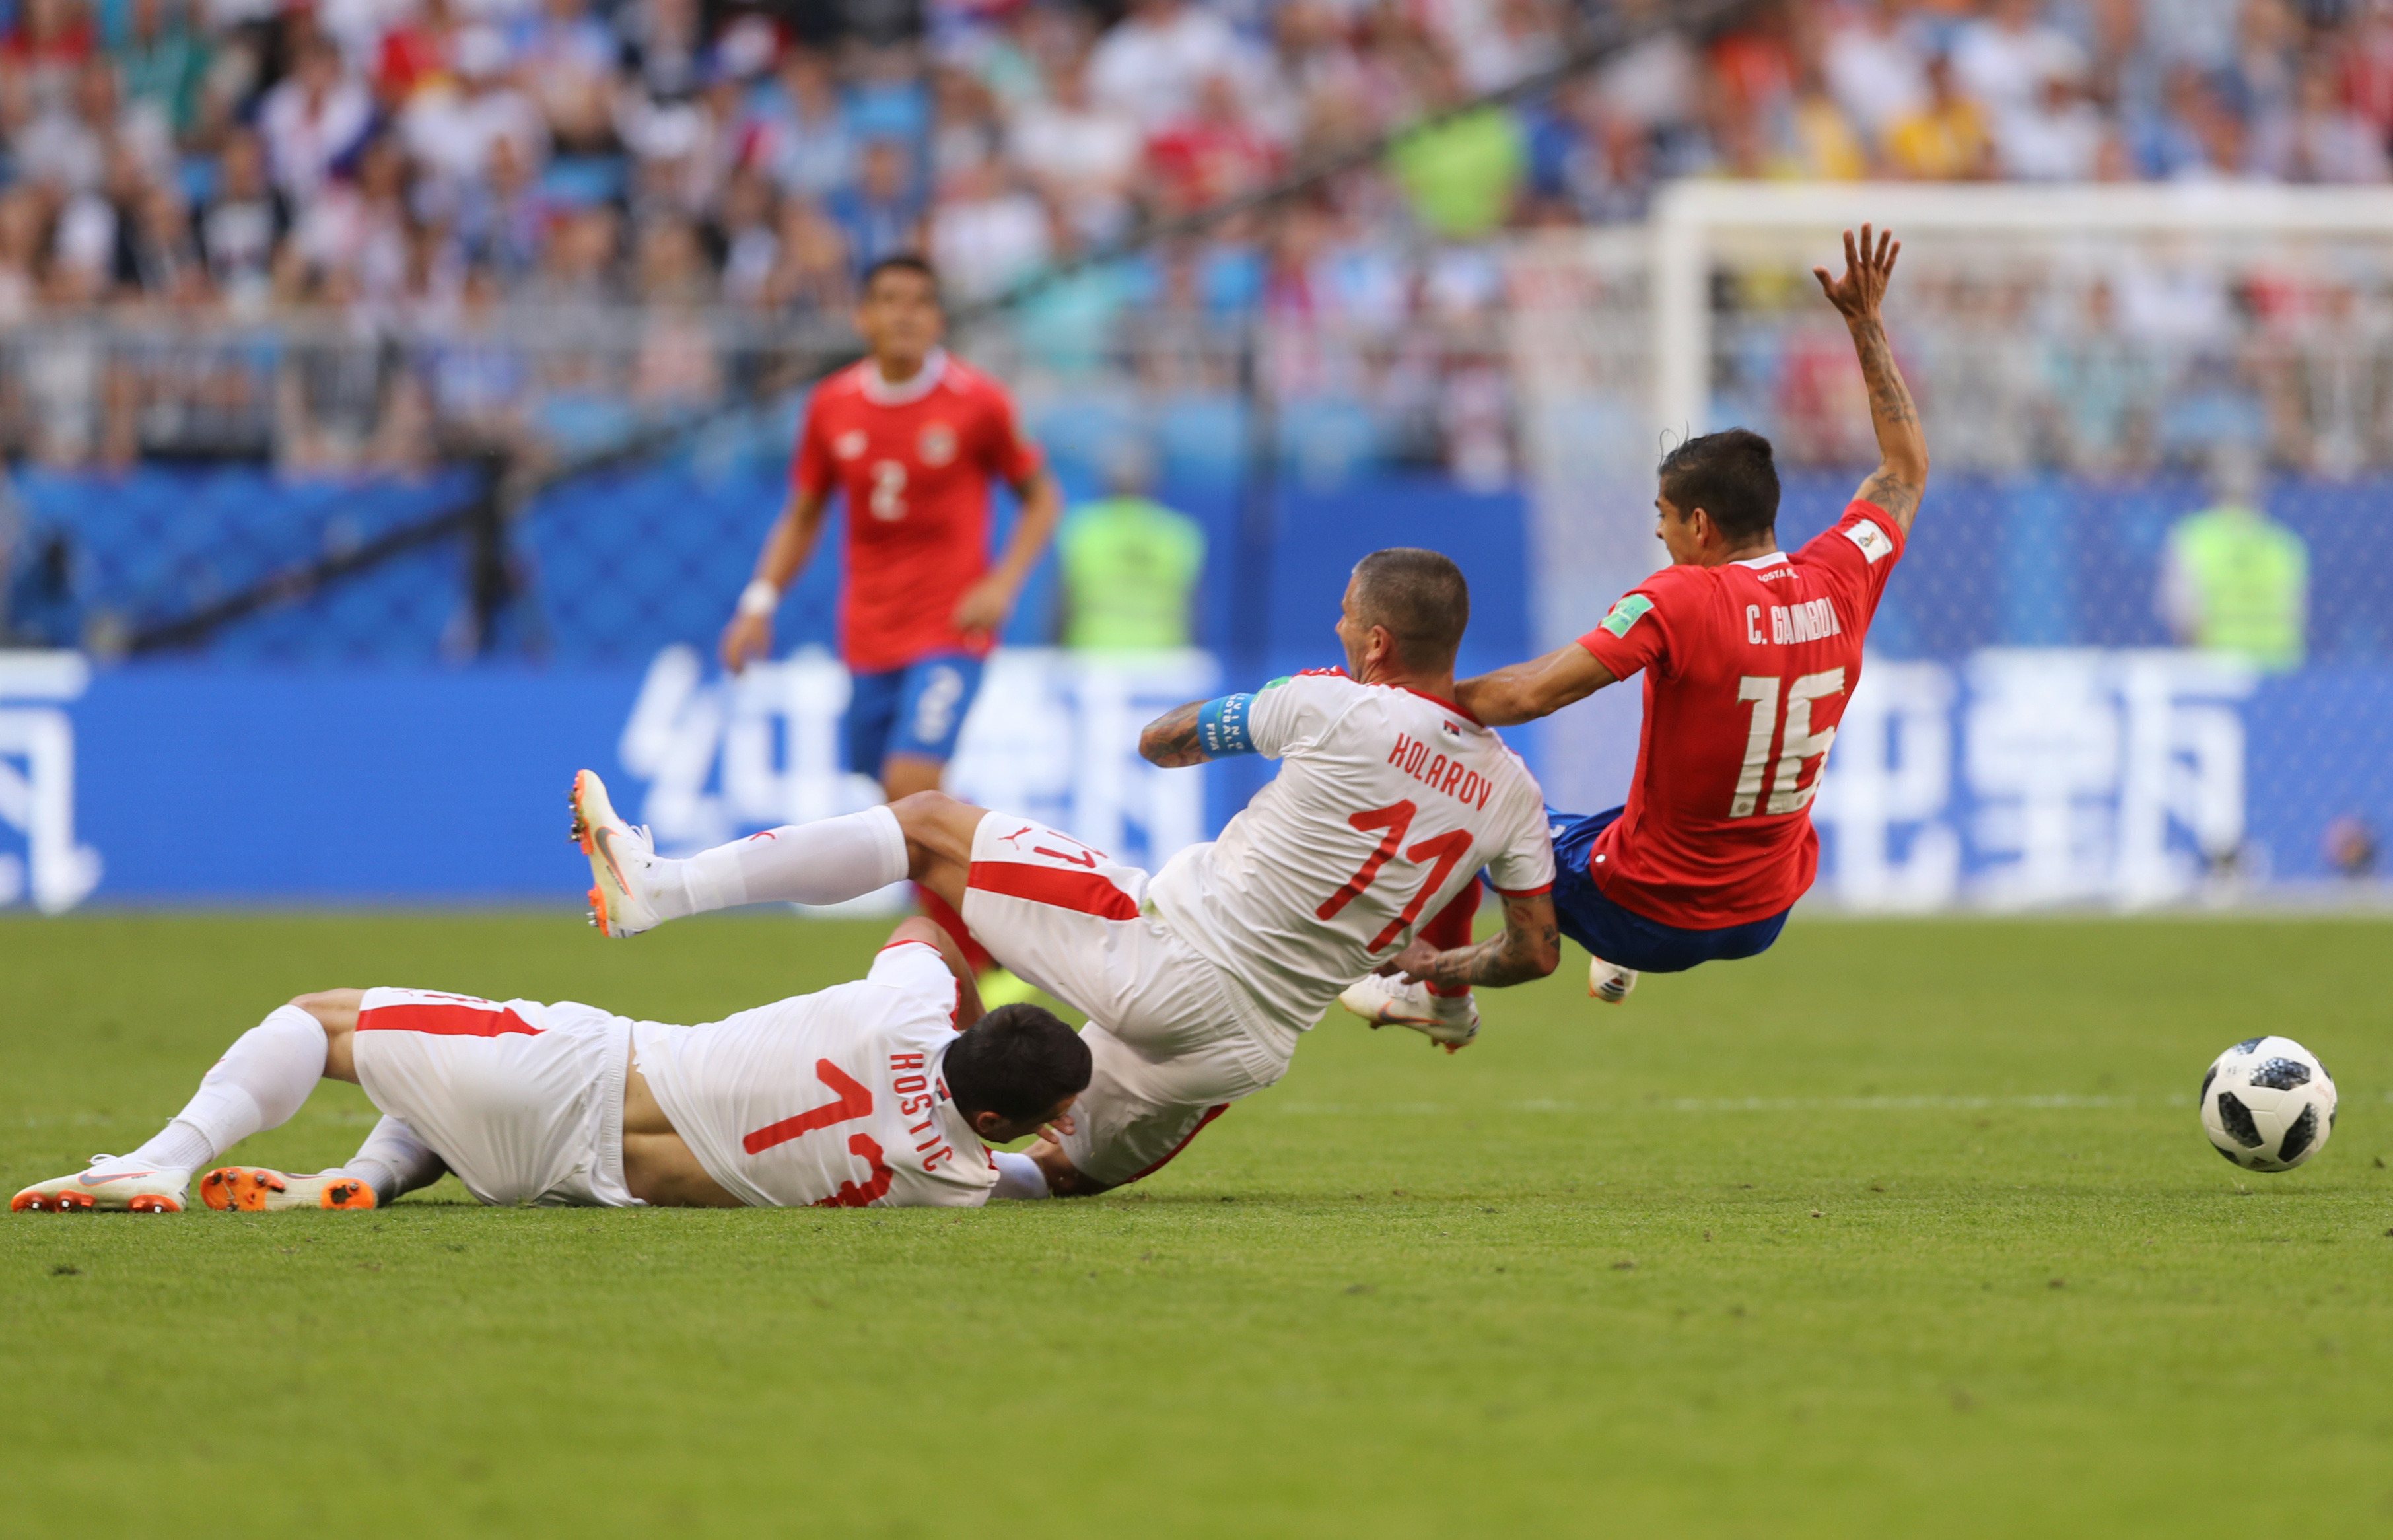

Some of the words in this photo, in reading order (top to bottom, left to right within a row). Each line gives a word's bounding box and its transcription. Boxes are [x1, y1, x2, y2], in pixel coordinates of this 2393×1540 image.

[868, 459, 909, 522] 2
[1745, 604, 1768, 645] C.
[1770, 596, 1842, 645] GAMBOA
[1206, 722, 1220, 751] FIFA
[1387, 732, 1492, 812] KOLAROV
[1727, 666, 1846, 819] 16
[1316, 799, 1473, 954] 11
